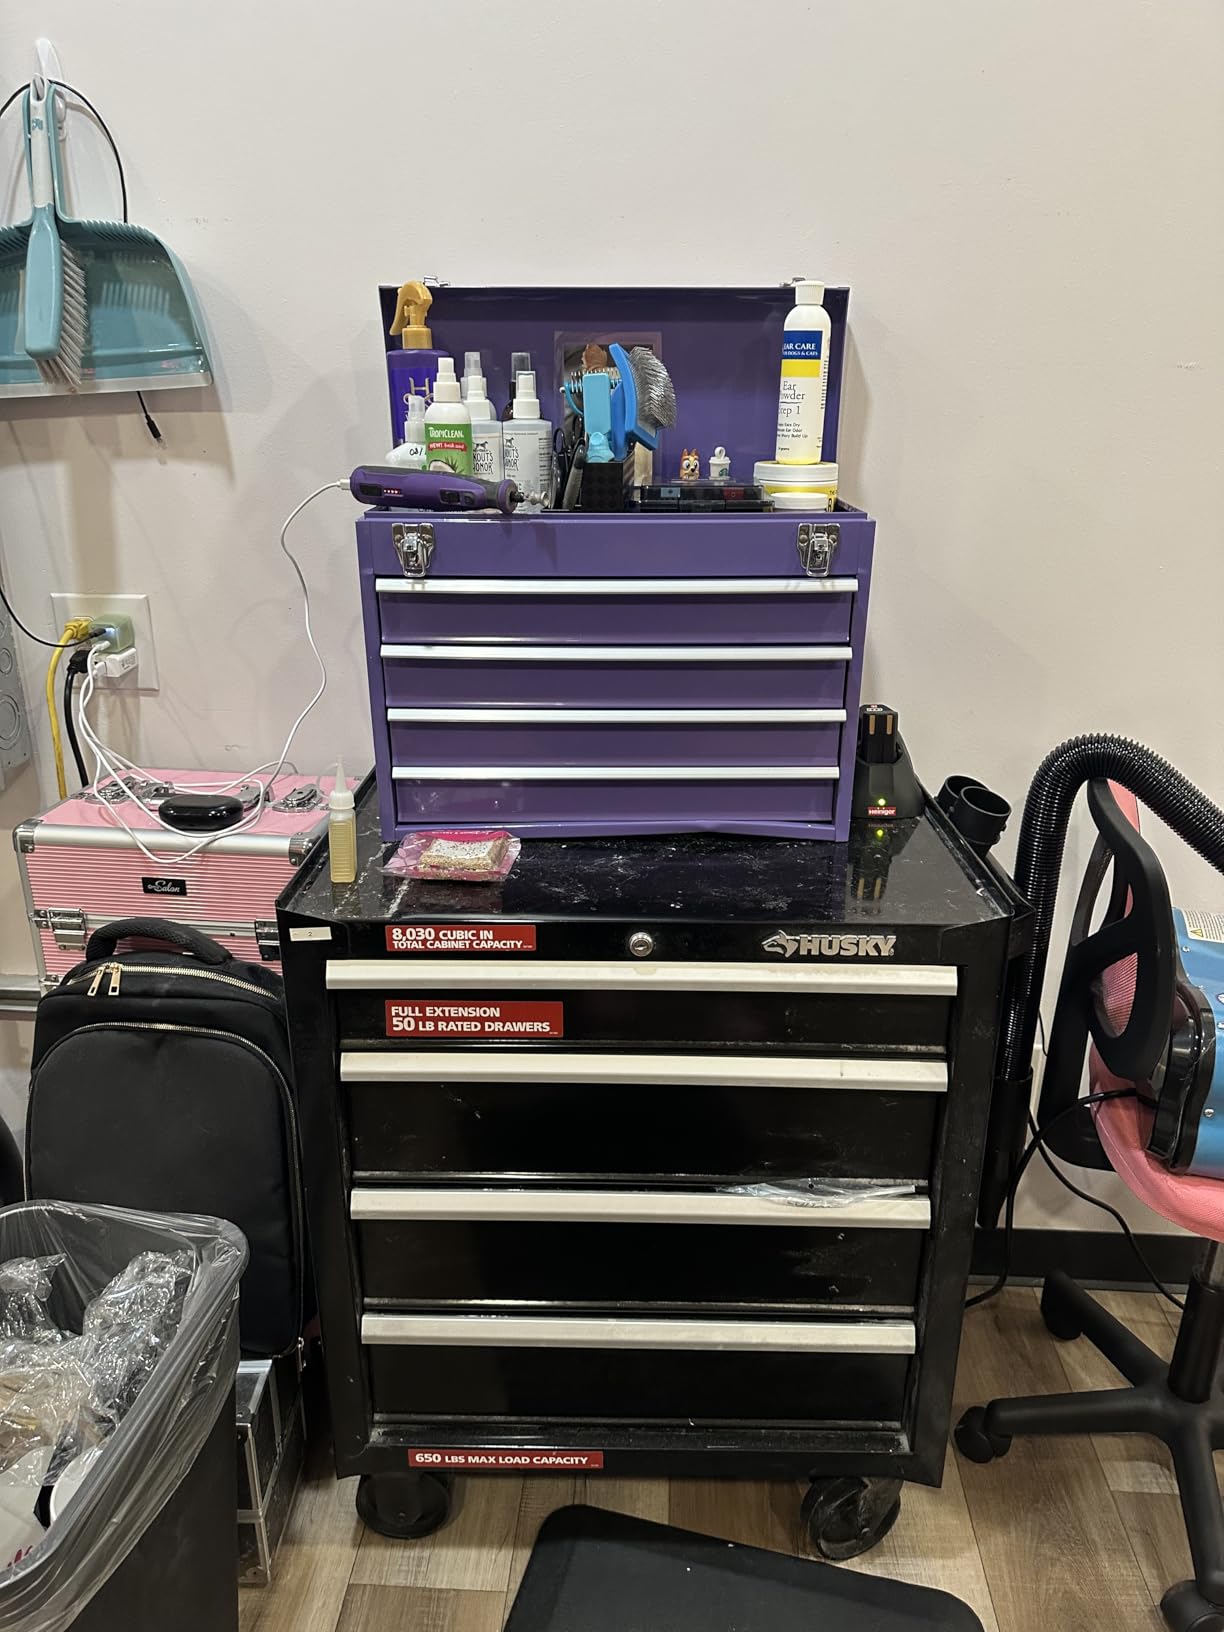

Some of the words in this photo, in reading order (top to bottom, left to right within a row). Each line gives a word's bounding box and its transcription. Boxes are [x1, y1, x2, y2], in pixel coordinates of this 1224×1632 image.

[795, 342, 817, 350] CARE
[784, 380, 797, 391] Ear
[781, 390, 806, 400] owder
[392, 928, 435, 942] 8,030
[439, 930, 477, 940] CUBIC
[479, 930, 494, 940] IN
[392, 940, 425, 949] TOTAL
[426, 940, 471, 949] CABINET
[472, 940, 523, 949] CAPACITY
[800, 935, 897, 956] HUSKY
[391, 1006, 423, 1017] FULL
[425, 1006, 500, 1018] EXTENSION
[392, 1017, 416, 1031] 50
[418, 1021, 435, 1031] LB
[437, 1021, 481, 1032] RATED
[484, 1022, 551, 1033] DRAWERS
[415, 1453, 442, 1463] 650
[445, 1455, 465, 1463] LBS
[468, 1455, 496, 1464] MAX
[499, 1456, 530, 1464] LOAD
[533, 1456, 588, 1465] CAPACITY
